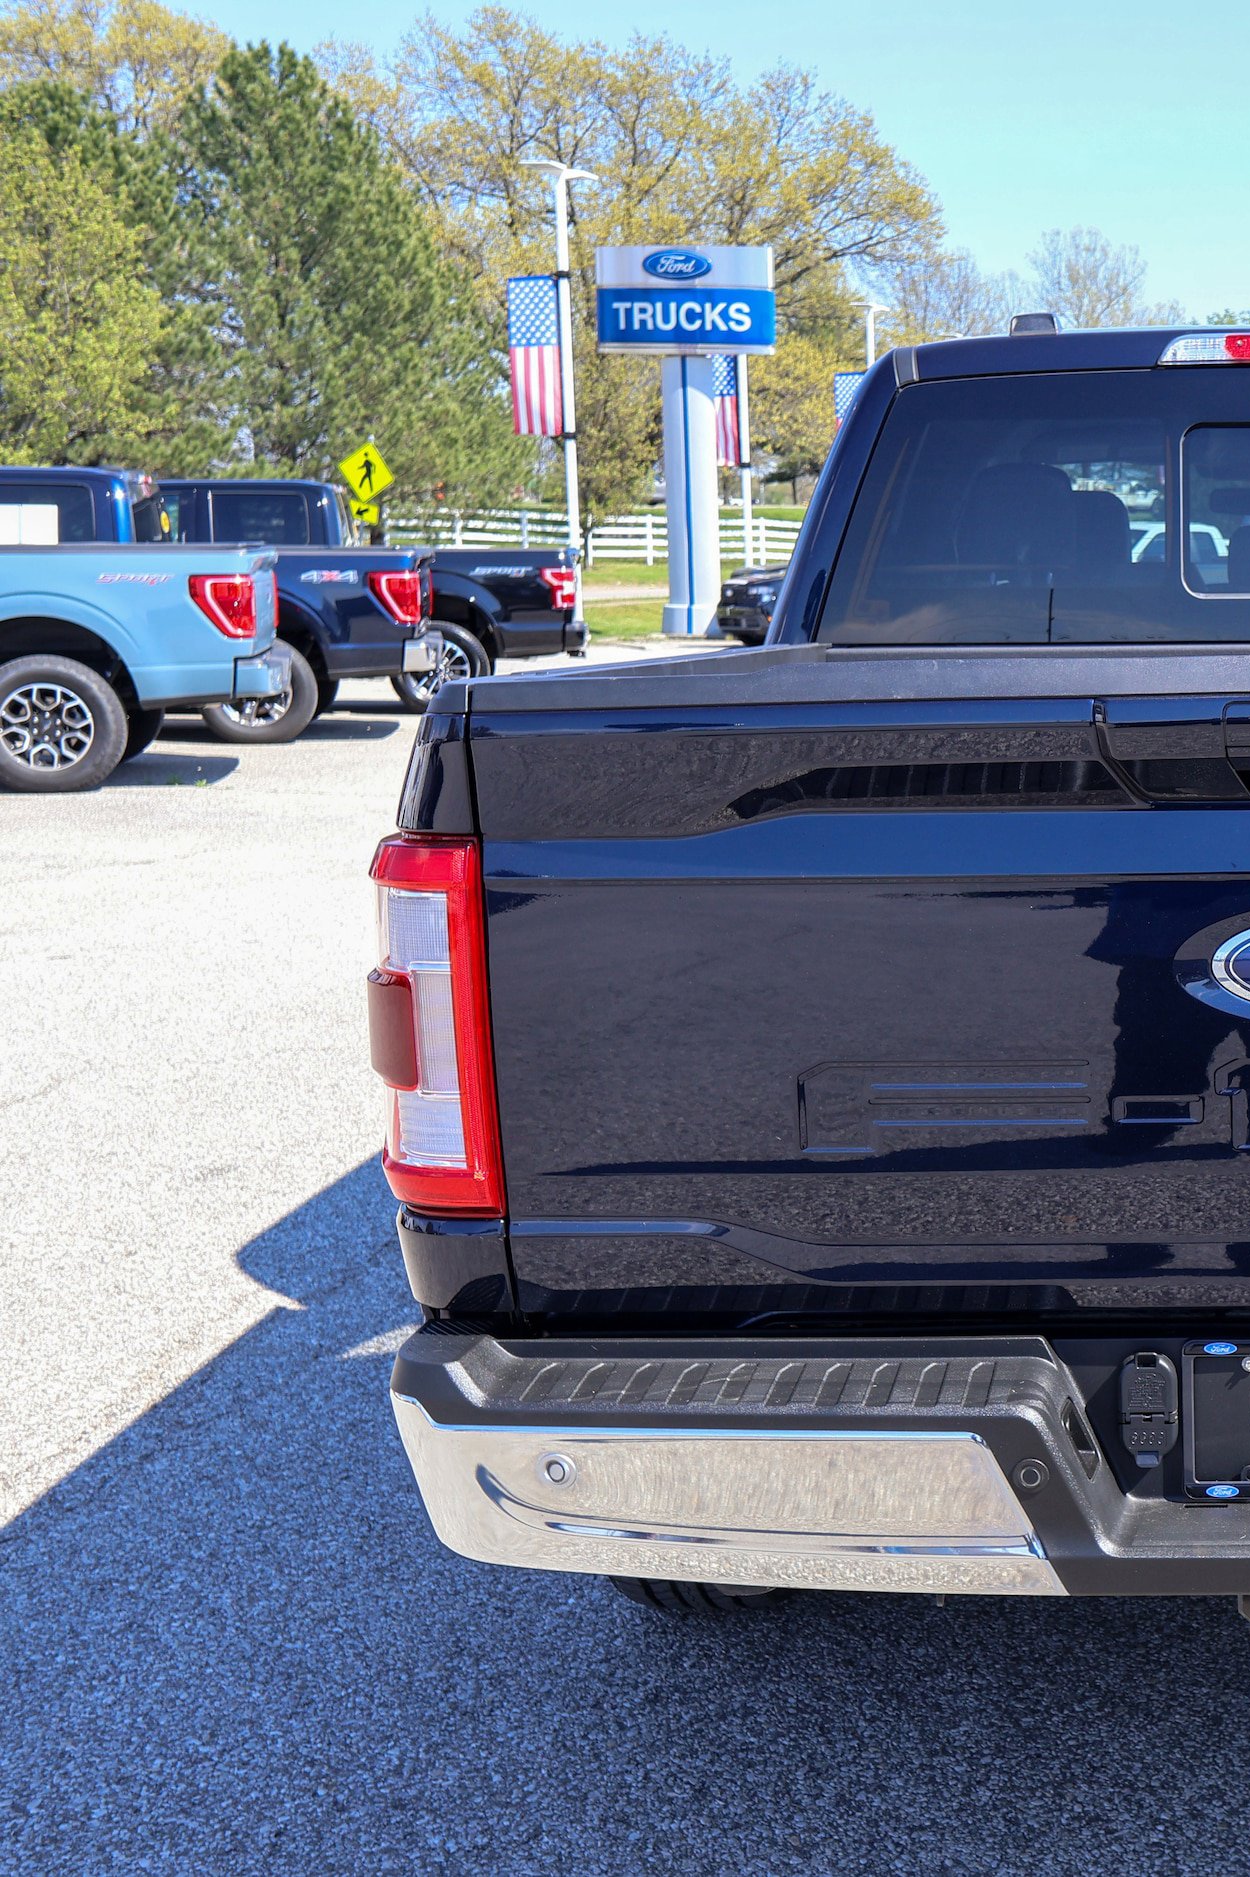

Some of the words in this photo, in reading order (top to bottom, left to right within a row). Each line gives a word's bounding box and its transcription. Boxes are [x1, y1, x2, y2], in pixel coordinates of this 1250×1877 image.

[656, 255, 696, 273] Ford
[612, 301, 752, 332] TRUCKS
[96, 573, 175, 585] SPORT
[469, 566, 533, 577] SPORT
